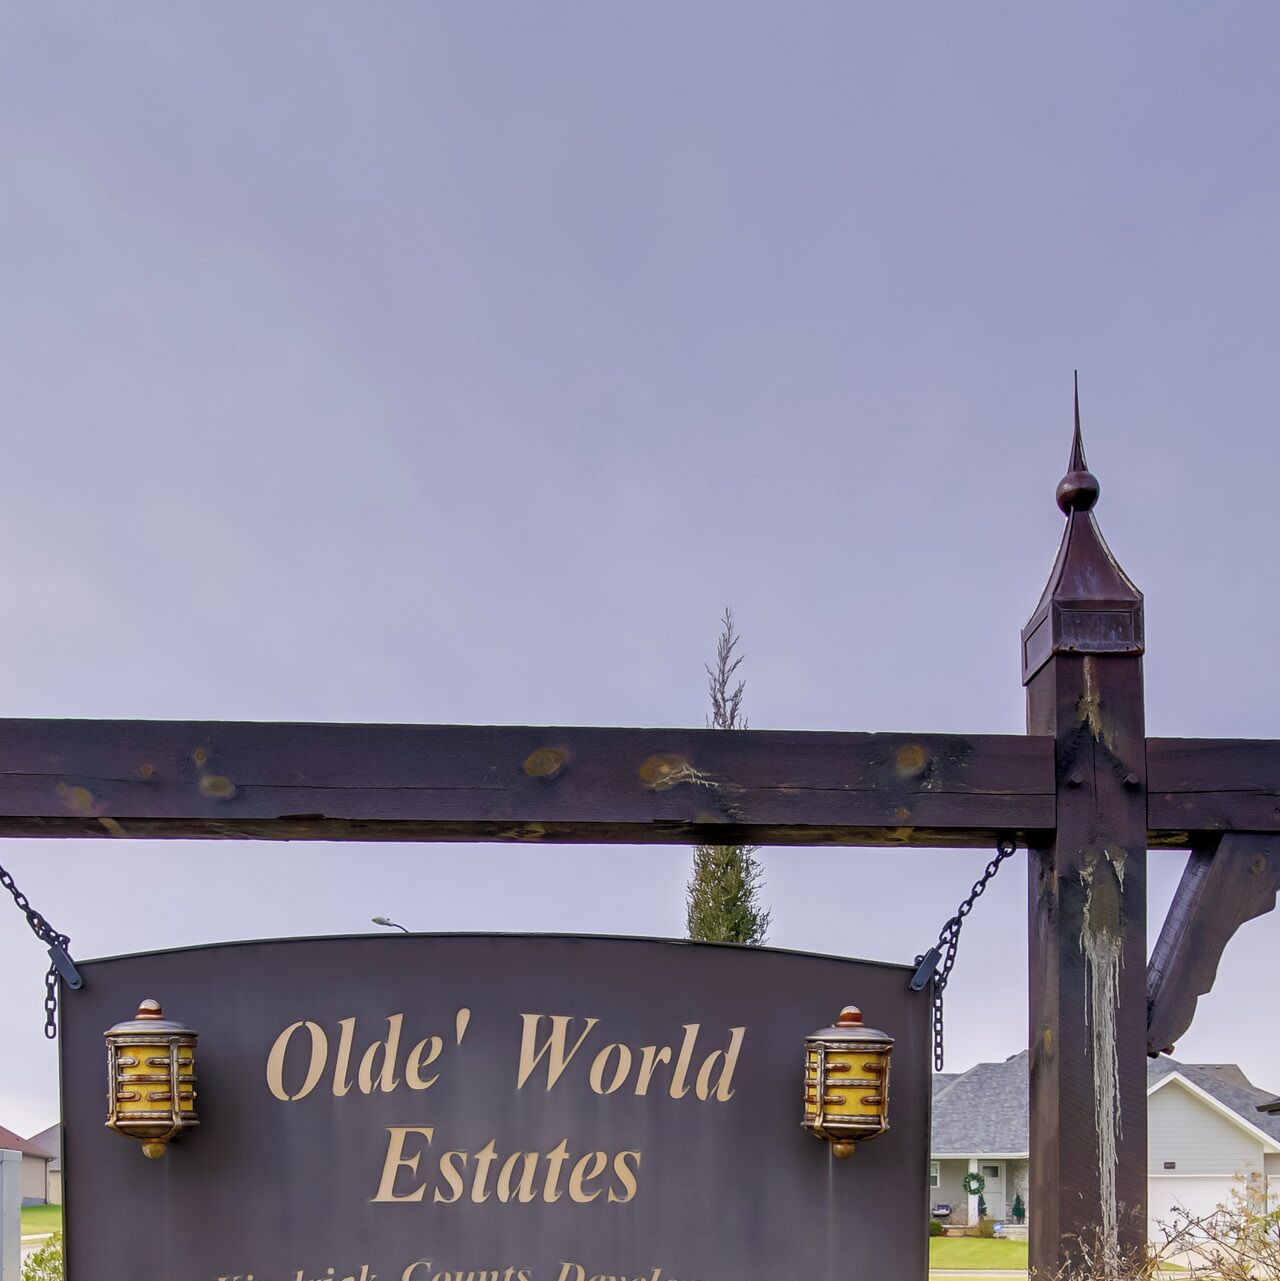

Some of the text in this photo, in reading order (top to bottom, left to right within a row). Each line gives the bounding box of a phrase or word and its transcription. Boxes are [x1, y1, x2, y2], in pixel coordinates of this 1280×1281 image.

[266, 1007, 746, 1102] Olde' World
[371, 1126, 643, 1204] Estates
